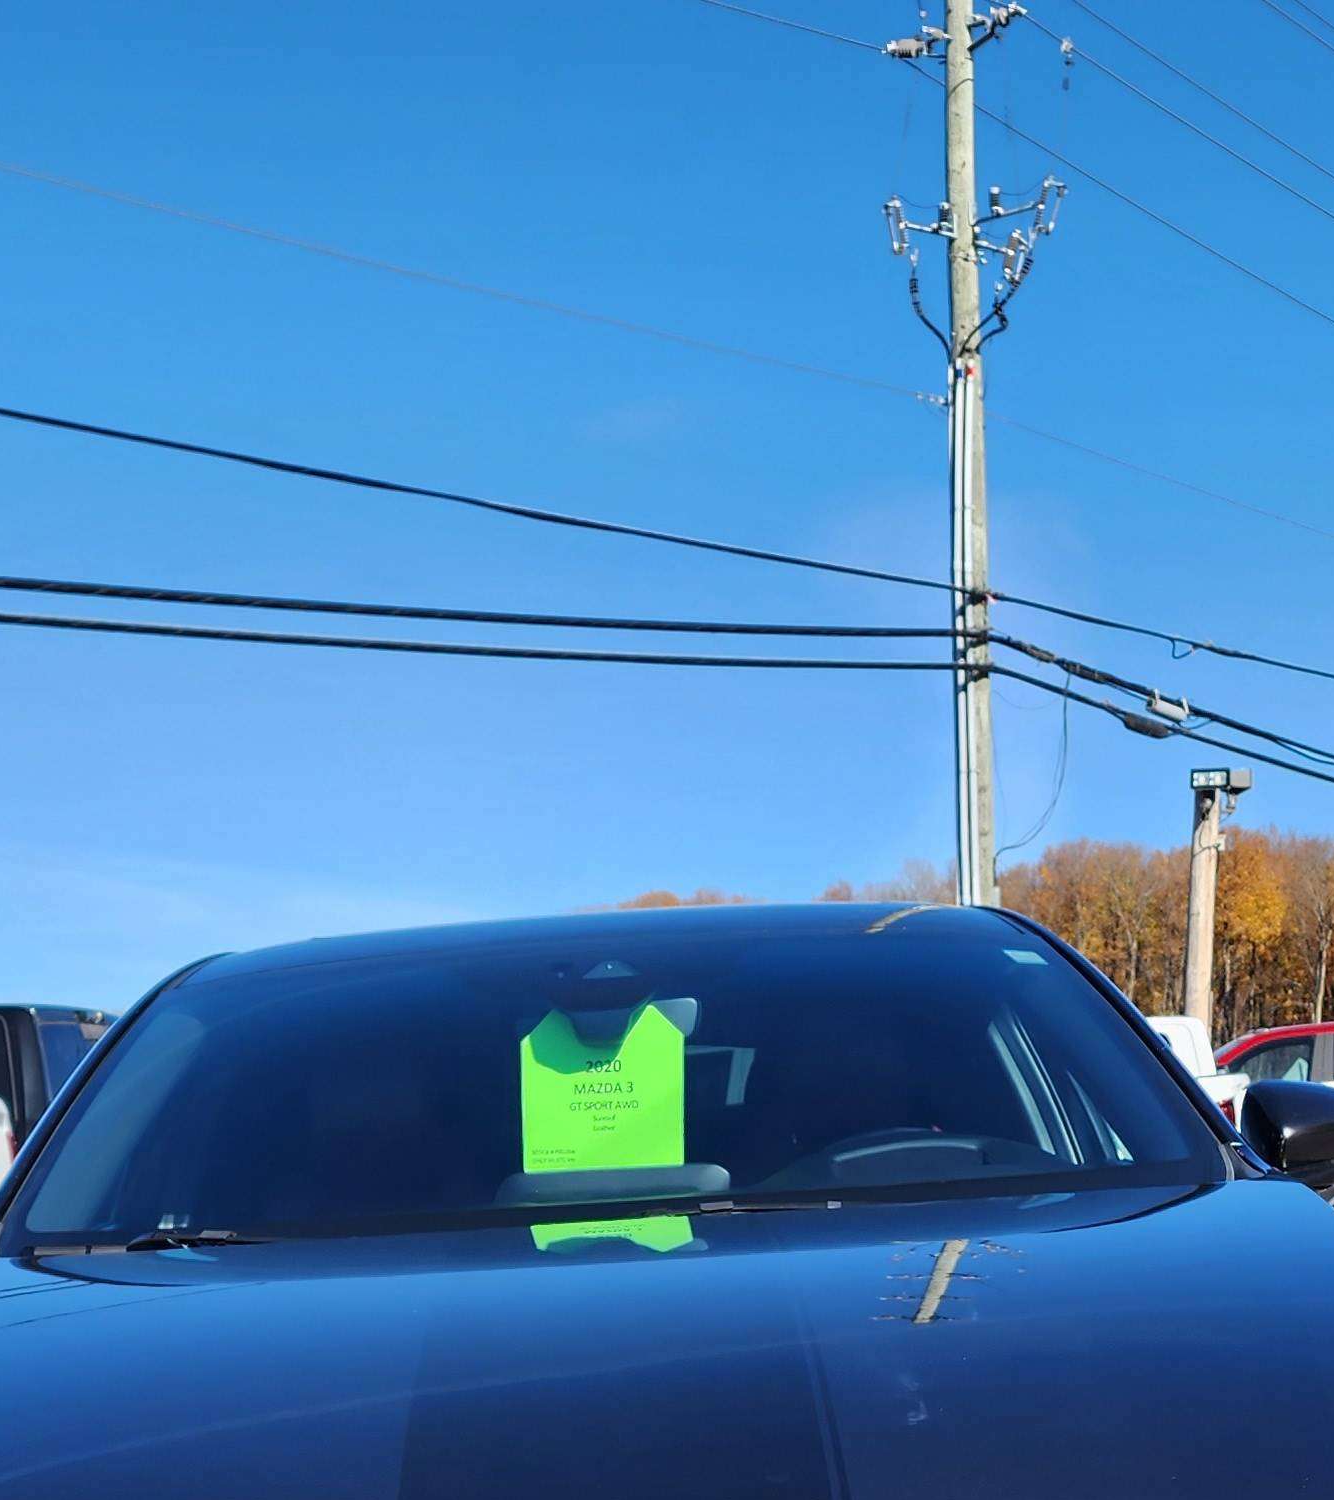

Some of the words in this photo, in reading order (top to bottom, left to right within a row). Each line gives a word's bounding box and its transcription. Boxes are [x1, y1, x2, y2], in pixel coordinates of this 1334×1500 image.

[585, 1059, 622, 1073] 2020
[574, 1082, 622, 1095] MAZDA
[626, 1081, 634, 1093] 3
[569, 1102, 582, 1111] GT
[583, 1100, 613, 1111] SPORT
[615, 1099, 639, 1110] AWD
